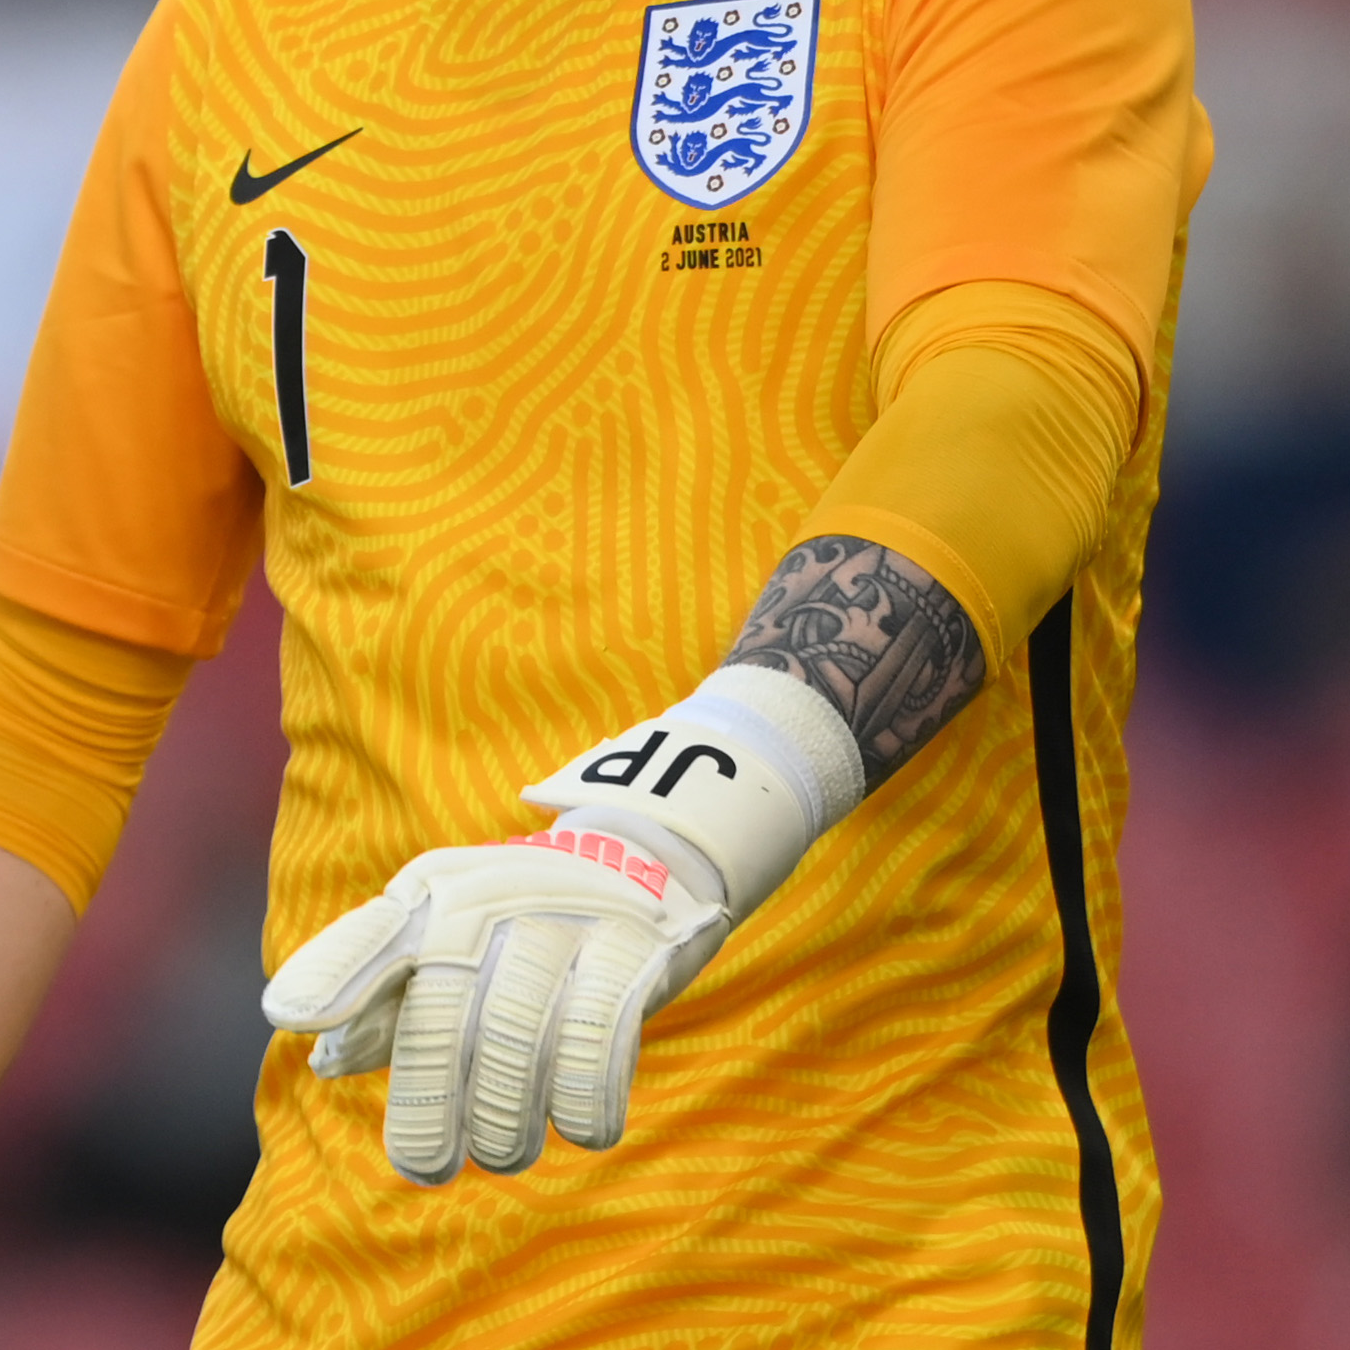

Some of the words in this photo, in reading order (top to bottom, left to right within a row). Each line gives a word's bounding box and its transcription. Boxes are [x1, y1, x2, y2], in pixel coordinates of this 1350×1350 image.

[672, 222, 749, 245] AUSTRIA
[661, 252, 670, 271] 2
[676, 249, 719, 270] JUNE
[725, 247, 762, 268] 2021
[262, 227, 312, 488] 1
[580, 730, 737, 798] JP
